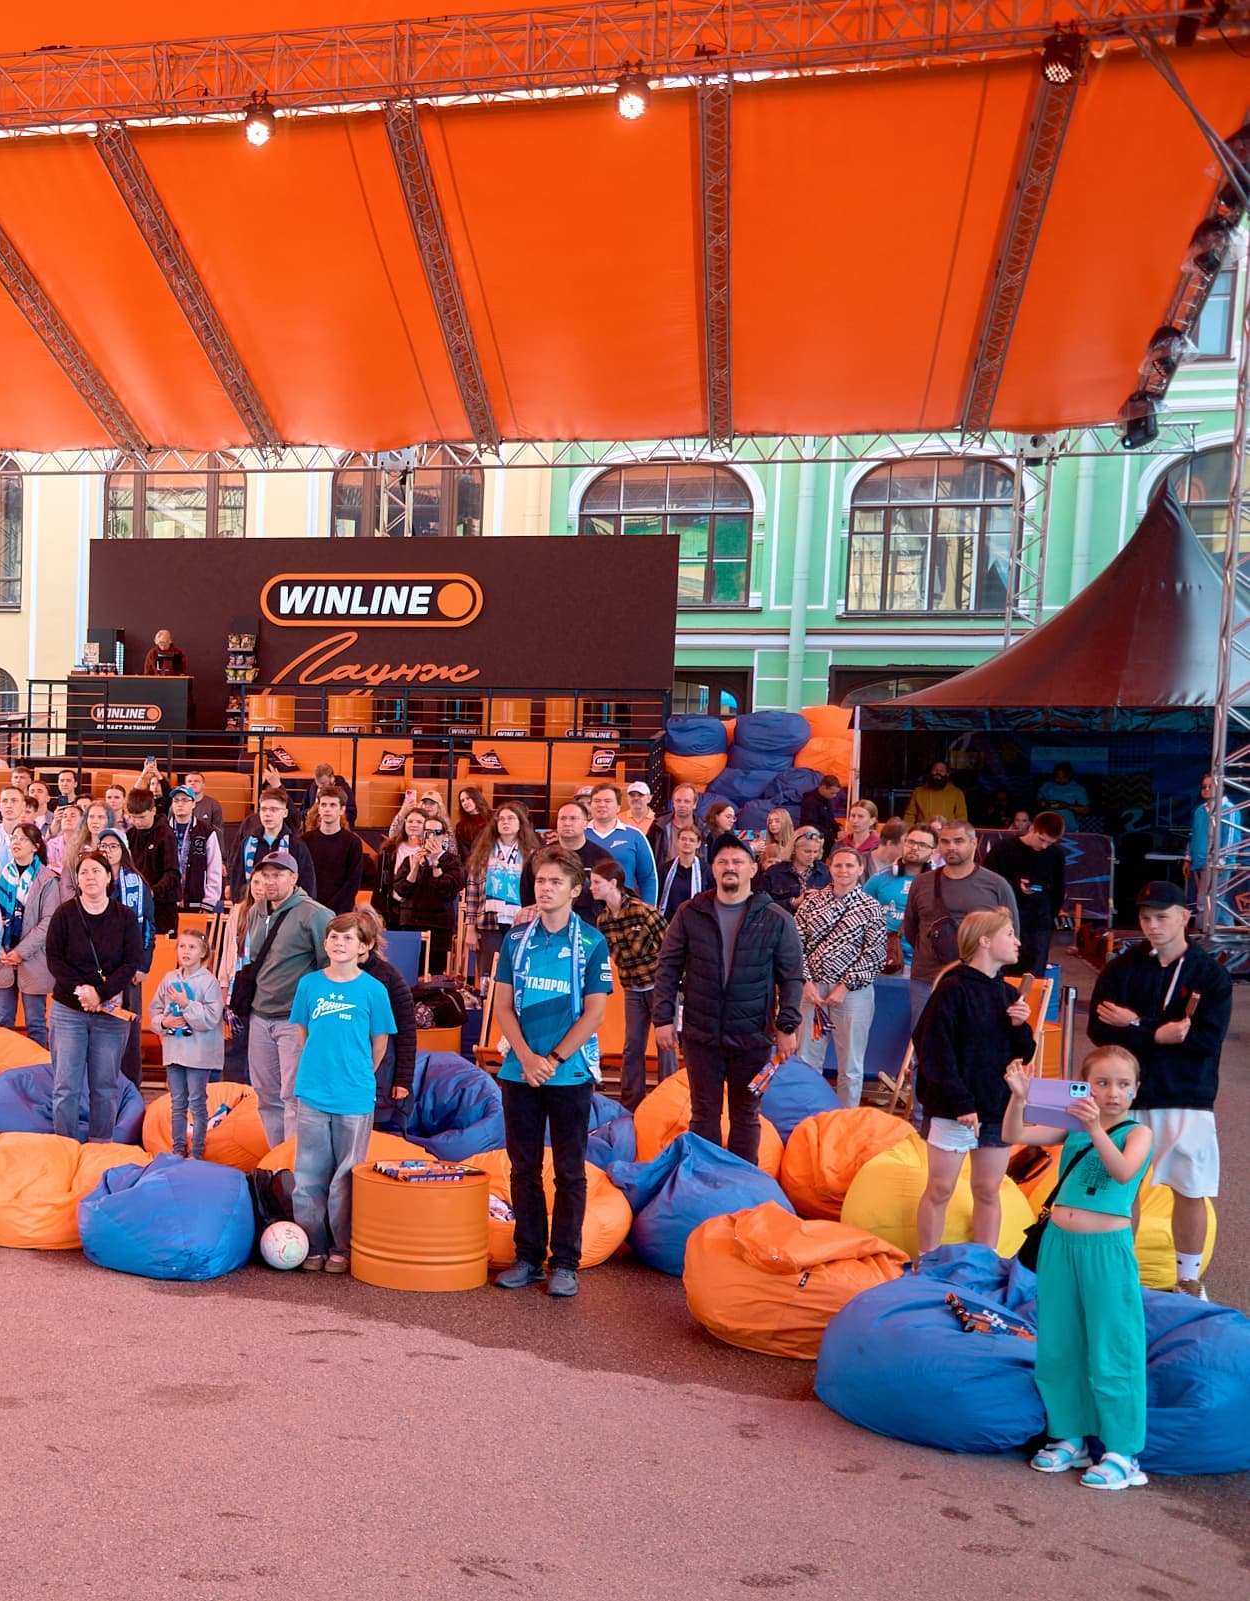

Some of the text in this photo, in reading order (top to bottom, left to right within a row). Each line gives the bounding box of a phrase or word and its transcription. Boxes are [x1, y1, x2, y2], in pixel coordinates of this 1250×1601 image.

[279, 585, 433, 615] WINLINE
[261, 631, 480, 696] Лаунж
[96, 707, 146, 719] WINLINE
